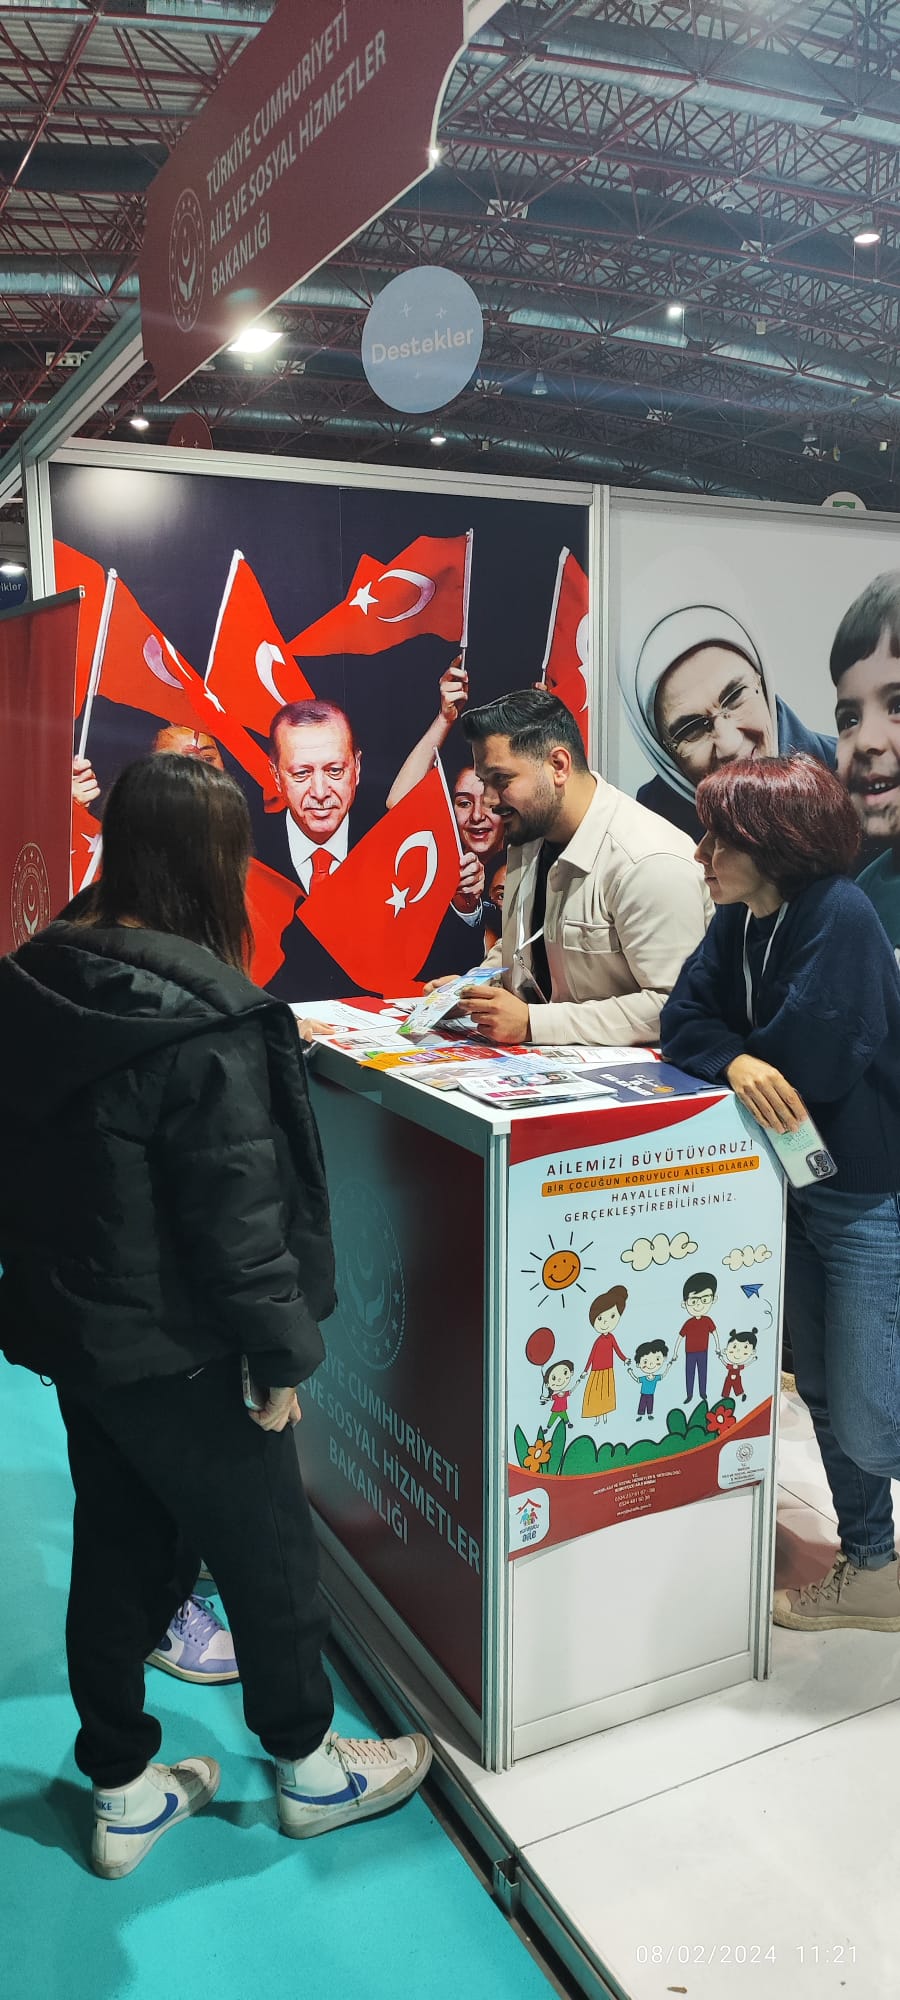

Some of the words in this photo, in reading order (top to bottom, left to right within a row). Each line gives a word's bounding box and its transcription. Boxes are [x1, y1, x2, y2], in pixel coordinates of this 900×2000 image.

[206, 123, 251, 201] TÜRKİYE
[253, 0, 348, 146] CUMHURİYETİ
[209, 206, 232, 250] AİLE
[232, 187, 248, 225] VE
[248, 131, 297, 207] SOSYAL
[299, 29, 386, 153] HİZMETLER
[211, 208, 271, 297] BAKANLIĞI
[371, 327, 474, 364] Destekler
[0, 581, 21, 592] ikler
[546, 1154, 623, 1176] AİLEMİZİ
[632, 1139, 754, 1167] BÜYÜTÜYORUZ!
[546, 1180, 564, 1193] BİR
[569, 1177, 620, 1191] ÇOCUĞUN
[625, 1170, 680, 1184] KORUYUCU
[684, 1164, 714, 1177] AİLESİ
[718, 1159, 755, 1172] OLARAK
[611, 1182, 695, 1202] HAYALLERİNİ
[309, 1376, 324, 1409] VE
[327, 1394, 379, 1469] SOSYAL
[383, 1449, 481, 1575] HİZMETLER
[350, 1371, 459, 1501] CUMHURİYETİ
[329, 1436, 408, 1545] BAKANLIĞI
